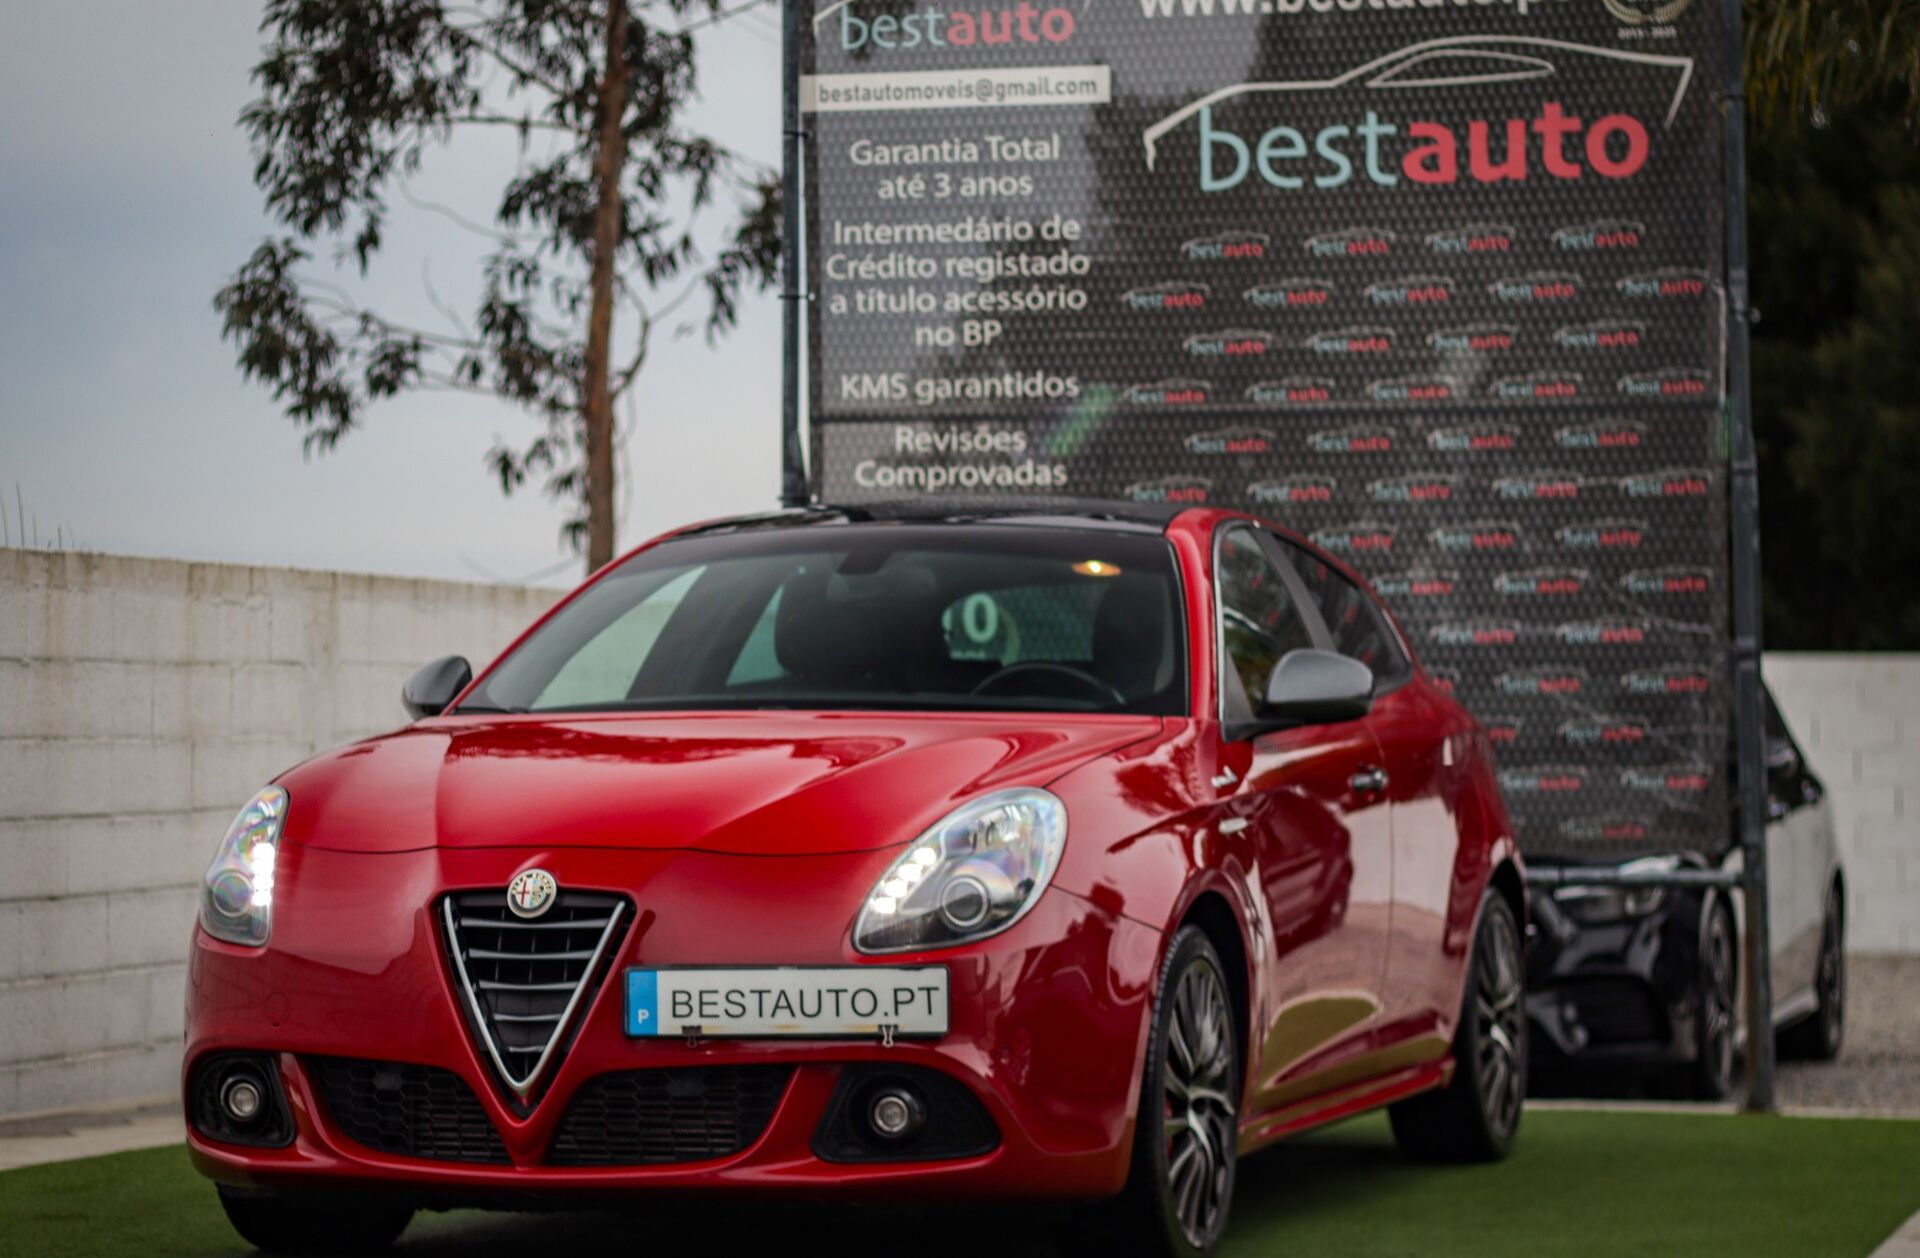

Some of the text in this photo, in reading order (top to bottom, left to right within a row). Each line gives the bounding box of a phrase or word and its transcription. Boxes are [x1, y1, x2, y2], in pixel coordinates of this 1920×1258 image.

[841, 1, 1076, 50] bestauto
[819, 78, 1098, 103] bestautomoveis@gmail.com
[850, 133, 1060, 166] Garantia Total
[1200, 102, 1650, 191] bestauto
[878, 173, 1033, 199] até 3 anos
[834, 213, 1081, 244] Intermedário de
[826, 248, 1091, 283] Crédito registado
[830, 285, 1088, 314] a título acessório
[916, 320, 1001, 347] no BP
[840, 370, 1080, 404] KMS garantidos
[895, 425, 1027, 452] Revisões
[855, 459, 1068, 492] Comprovadas
[638, 1009, 649, 1024] P
[671, 986, 940, 1019] BESTAUTO.PT
